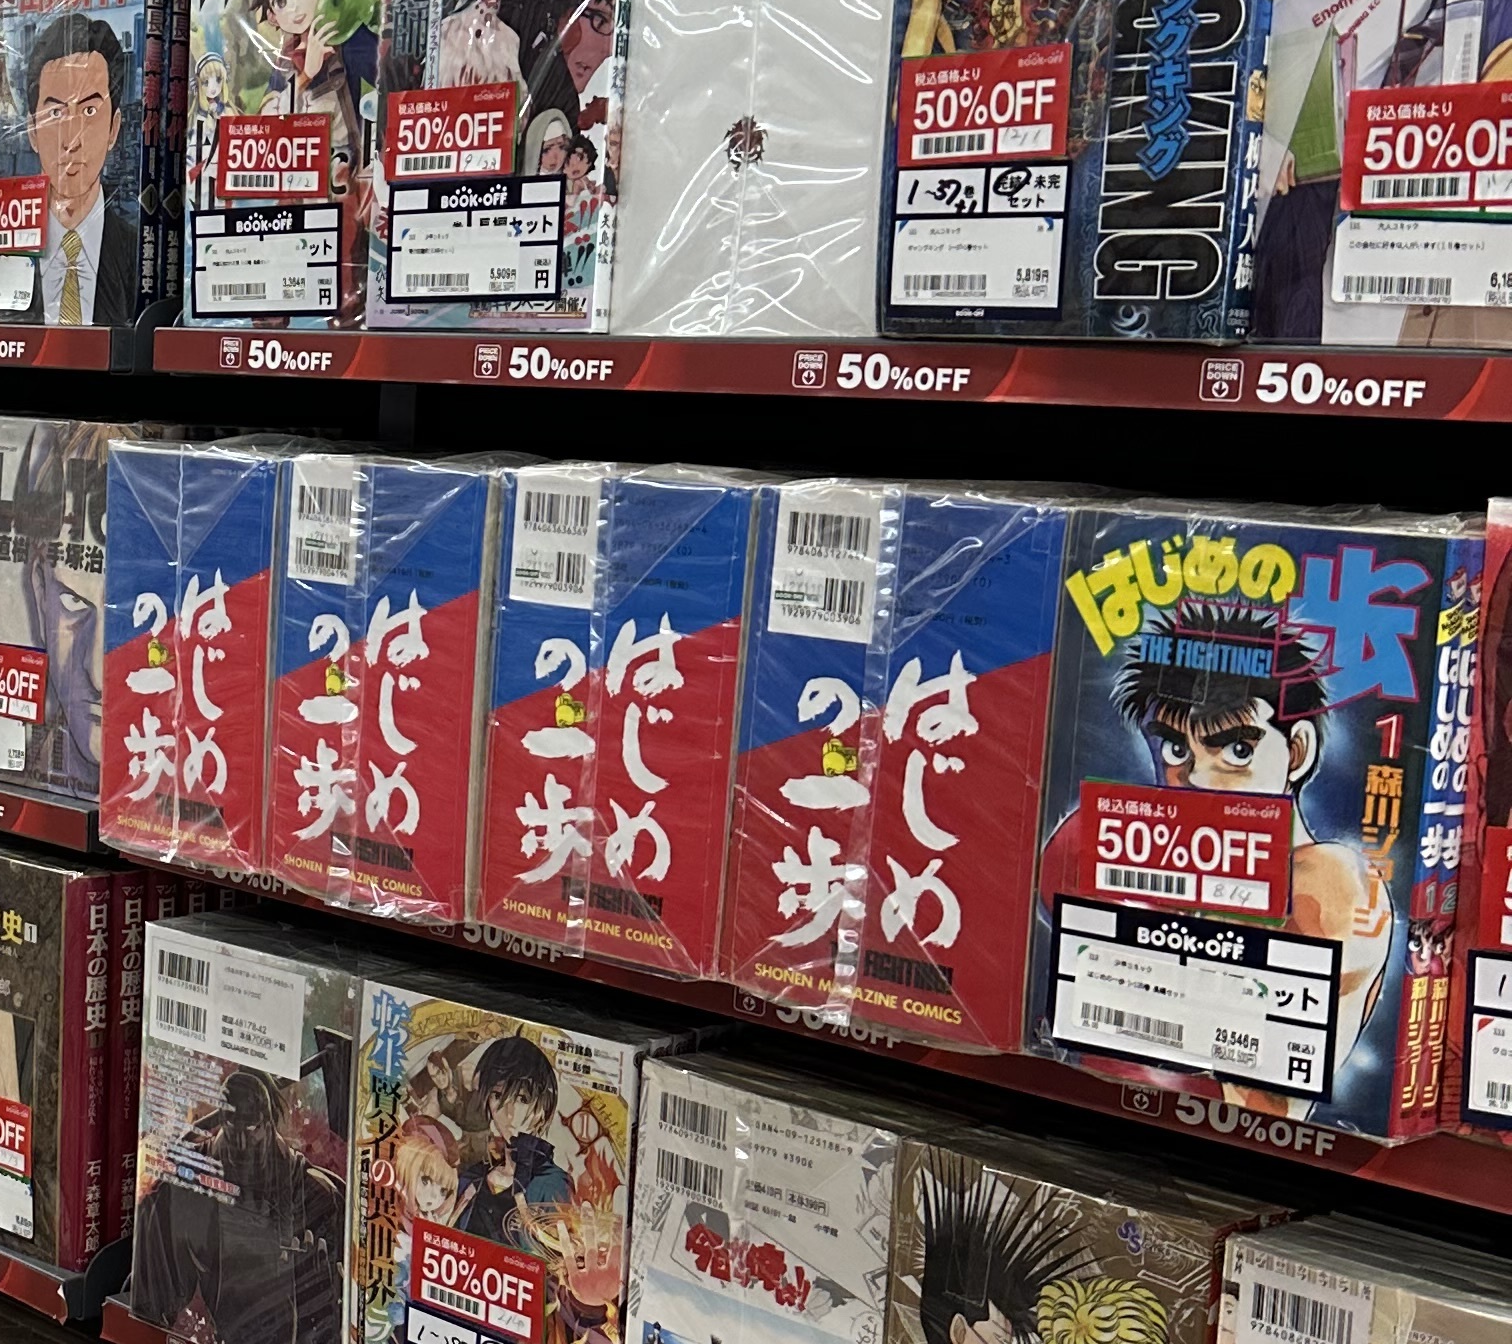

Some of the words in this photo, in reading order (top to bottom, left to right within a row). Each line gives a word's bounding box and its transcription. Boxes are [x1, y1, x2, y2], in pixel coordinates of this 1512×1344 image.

[914, 67, 982, 86] 税込価格より
[913, 79, 1057, 130] 50%OFF
[1366, 102, 1453, 121] 税込価格より
[227, 136, 321, 169] 50%OFF
[396, 112, 504, 154] 50%OFF
[1363, 118, 1512, 171] 50%OF
[1007, 193, 1045, 209] セット
[1235, 131, 1262, 293] 柳内大樹
[534, 269, 550, 290] 円
[247, 339, 333, 372] 50%OFF
[508, 346, 614, 382] 50%OFF
[836, 353, 971, 392] 50%OFF
[1207, 370, 1238, 380] DOWN
[1208, 361, 1238, 371] PRICE
[1255, 361, 1426, 410] 50%OFF
[1139, 631, 1172, 669] THE
[1173, 636, 1274, 681] FIGHTING!
[123, 590, 177, 803] の一歩
[178, 567, 231, 799] はじめ
[291, 612, 361, 842] の一歩
[364, 587, 432, 838] はじめ
[1376, 713, 1403, 761] 1
[514, 636, 598, 884] の一歩
[604, 611, 686, 881] はじめ
[768, 676, 871, 949] の一歩
[879, 649, 980, 949] はじめ
[1097, 796, 1178, 818] 税込価格より
[1096, 818, 1272, 876] 50%OFF
[502, 896, 553, 924] SHONEN
[624, 927, 674, 951] COMICS
[84, 903, 110, 1033] 日本の歴史
[754, 961, 814, 994] SHONEN
[902, 998, 963, 1027] COMICS
[1287, 1056, 1312, 1084] 円
[423, 1230, 475, 1258] 税込価格より
[421, 1250, 535, 1312] 50%OFF
